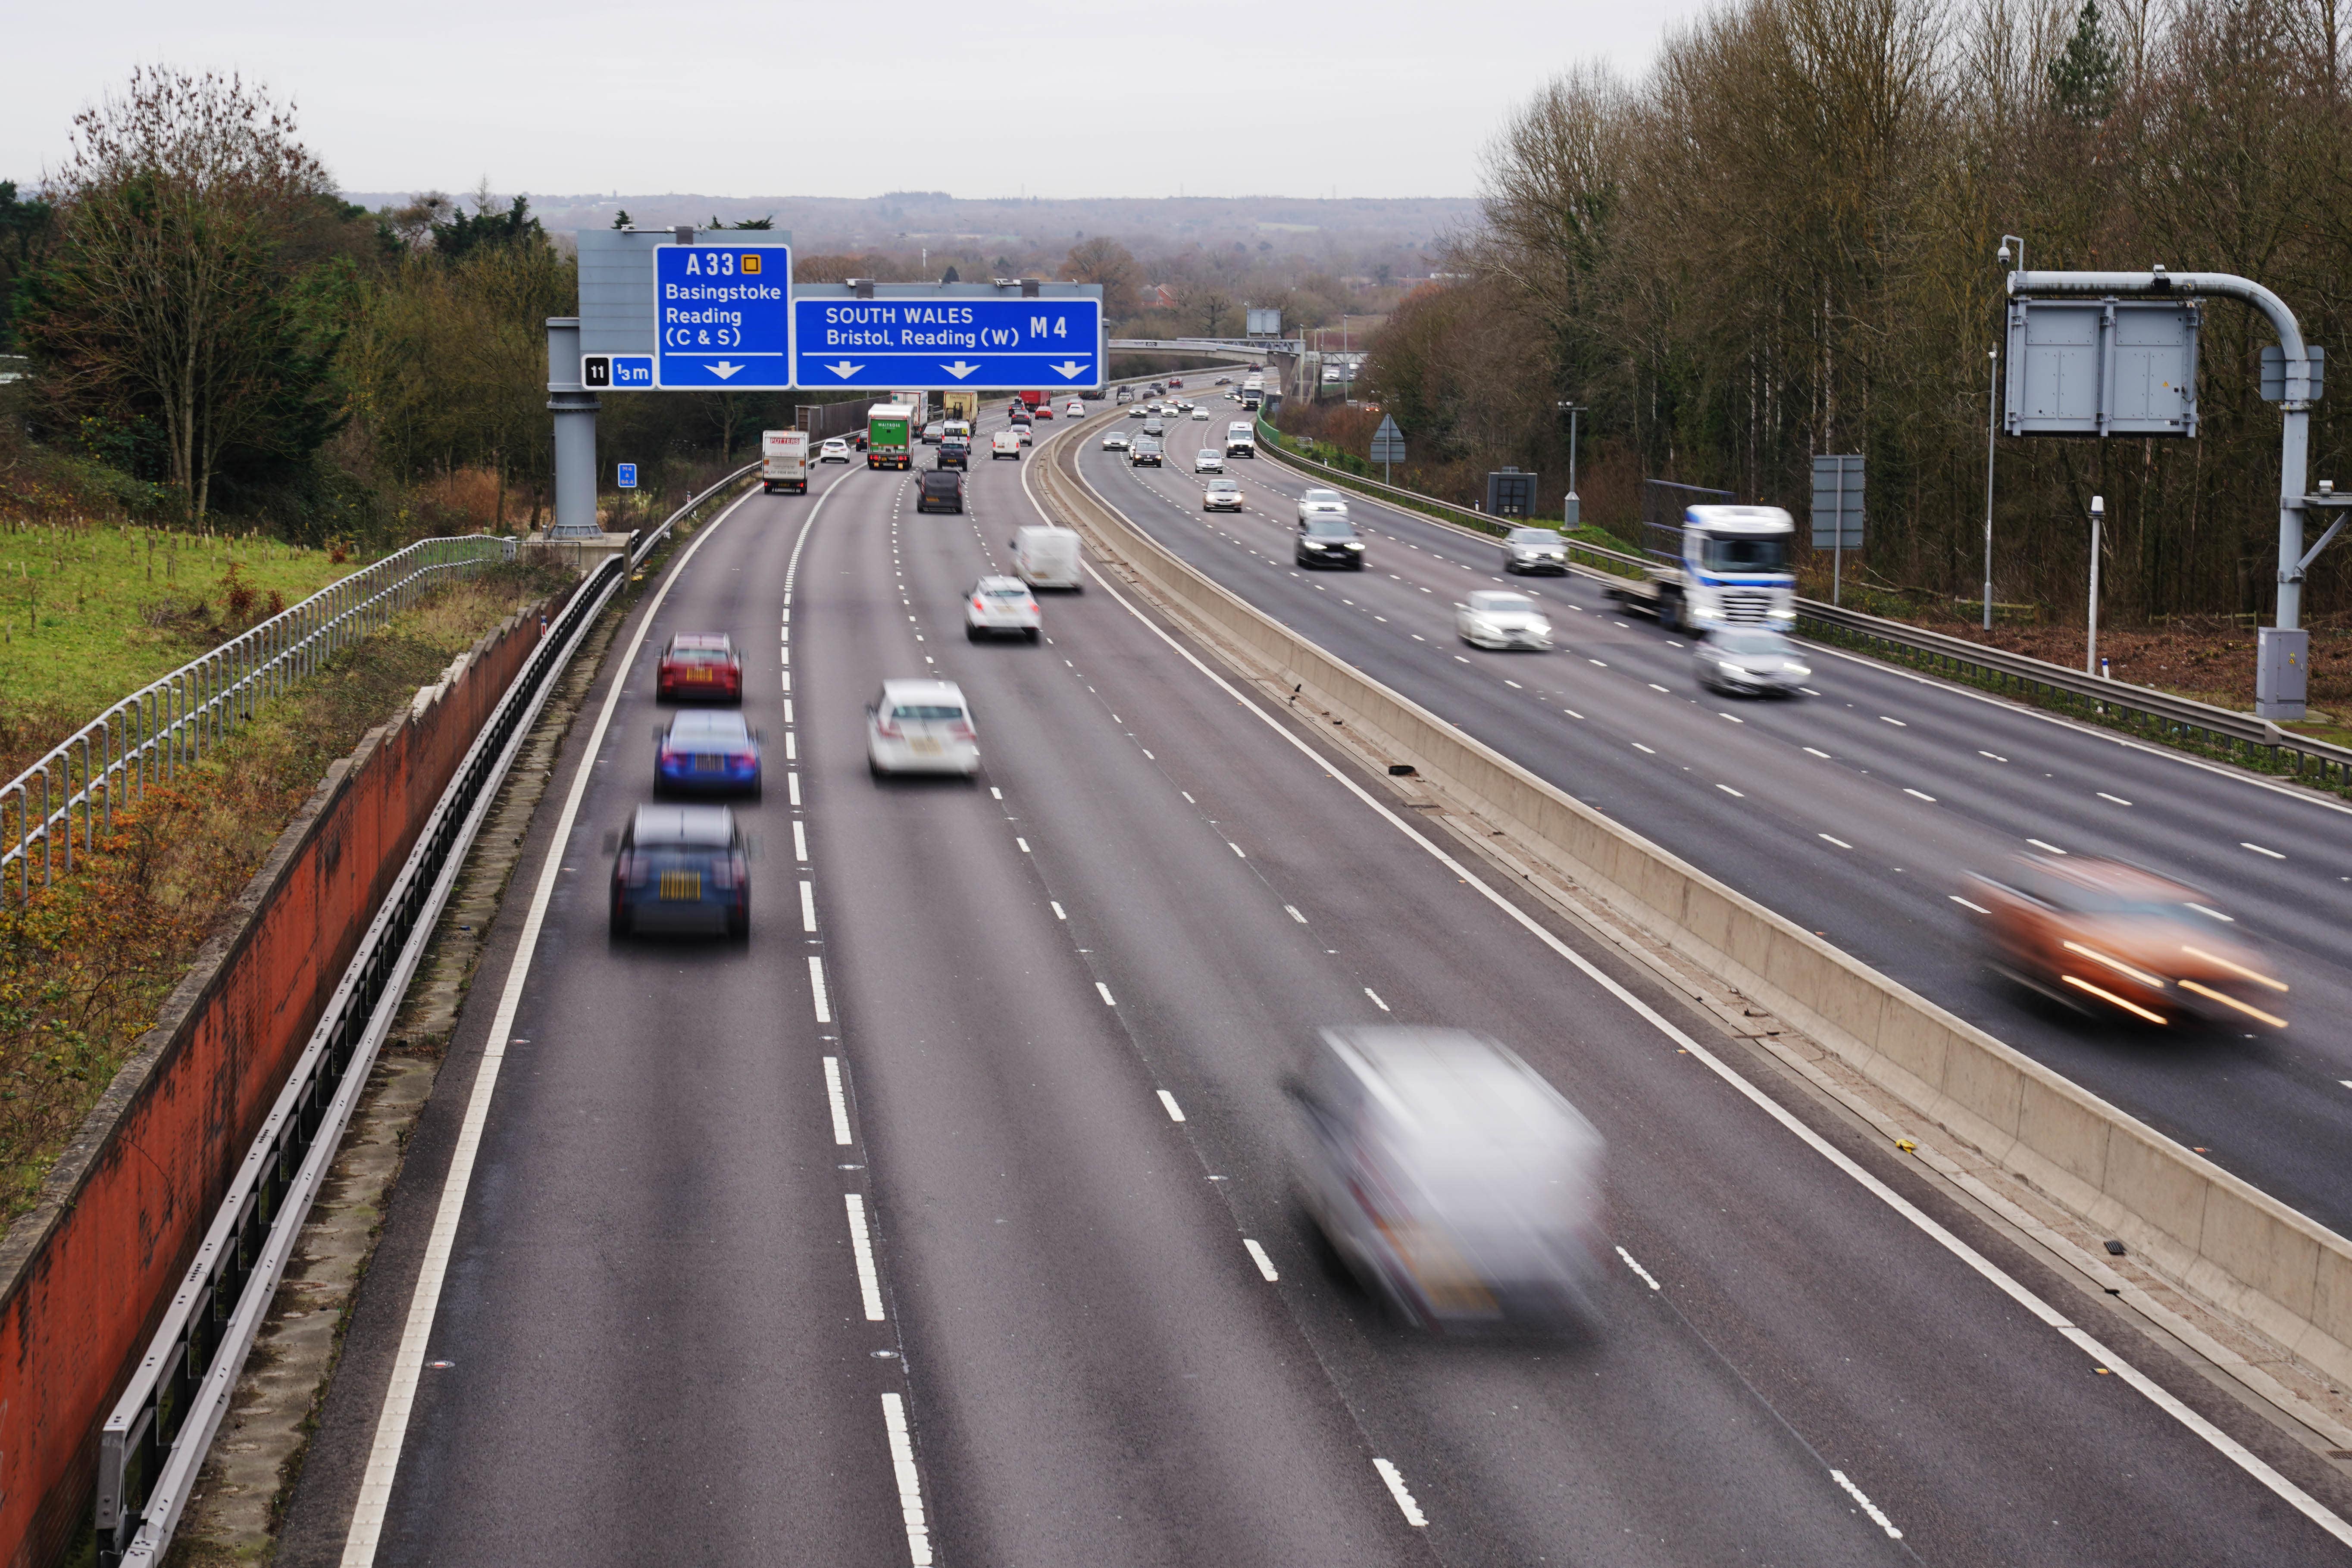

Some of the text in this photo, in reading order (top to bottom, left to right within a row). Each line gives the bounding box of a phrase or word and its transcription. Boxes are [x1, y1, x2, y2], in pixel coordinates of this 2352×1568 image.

[666, 283, 781, 303] Basingstoke
[666, 307, 741, 327] Reading
[826, 307, 973, 324] SOUTH WALES
[666, 327, 741, 347] (C & S)
[827, 327, 1019, 348] Bristol, Reading (W)
[591, 365, 604, 378] 11
